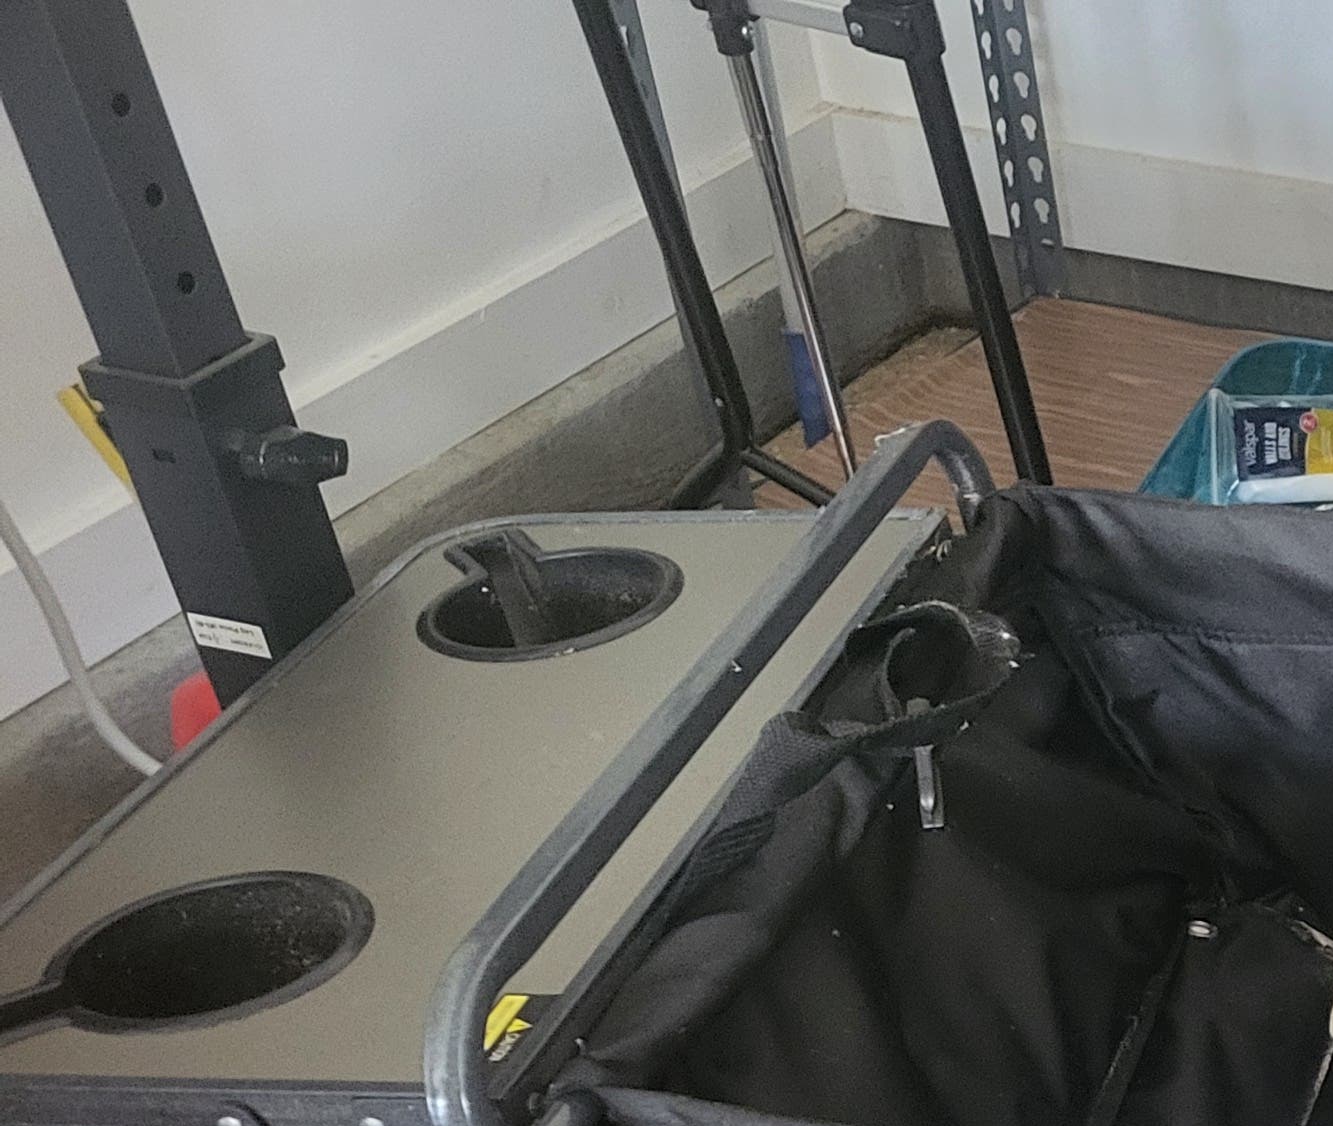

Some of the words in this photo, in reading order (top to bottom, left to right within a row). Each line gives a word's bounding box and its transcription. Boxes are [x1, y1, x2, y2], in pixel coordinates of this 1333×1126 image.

[1242, 420, 1259, 466] valspar
[1264, 422, 1277, 439] AND
[1264, 440, 1278, 465] WALLS
